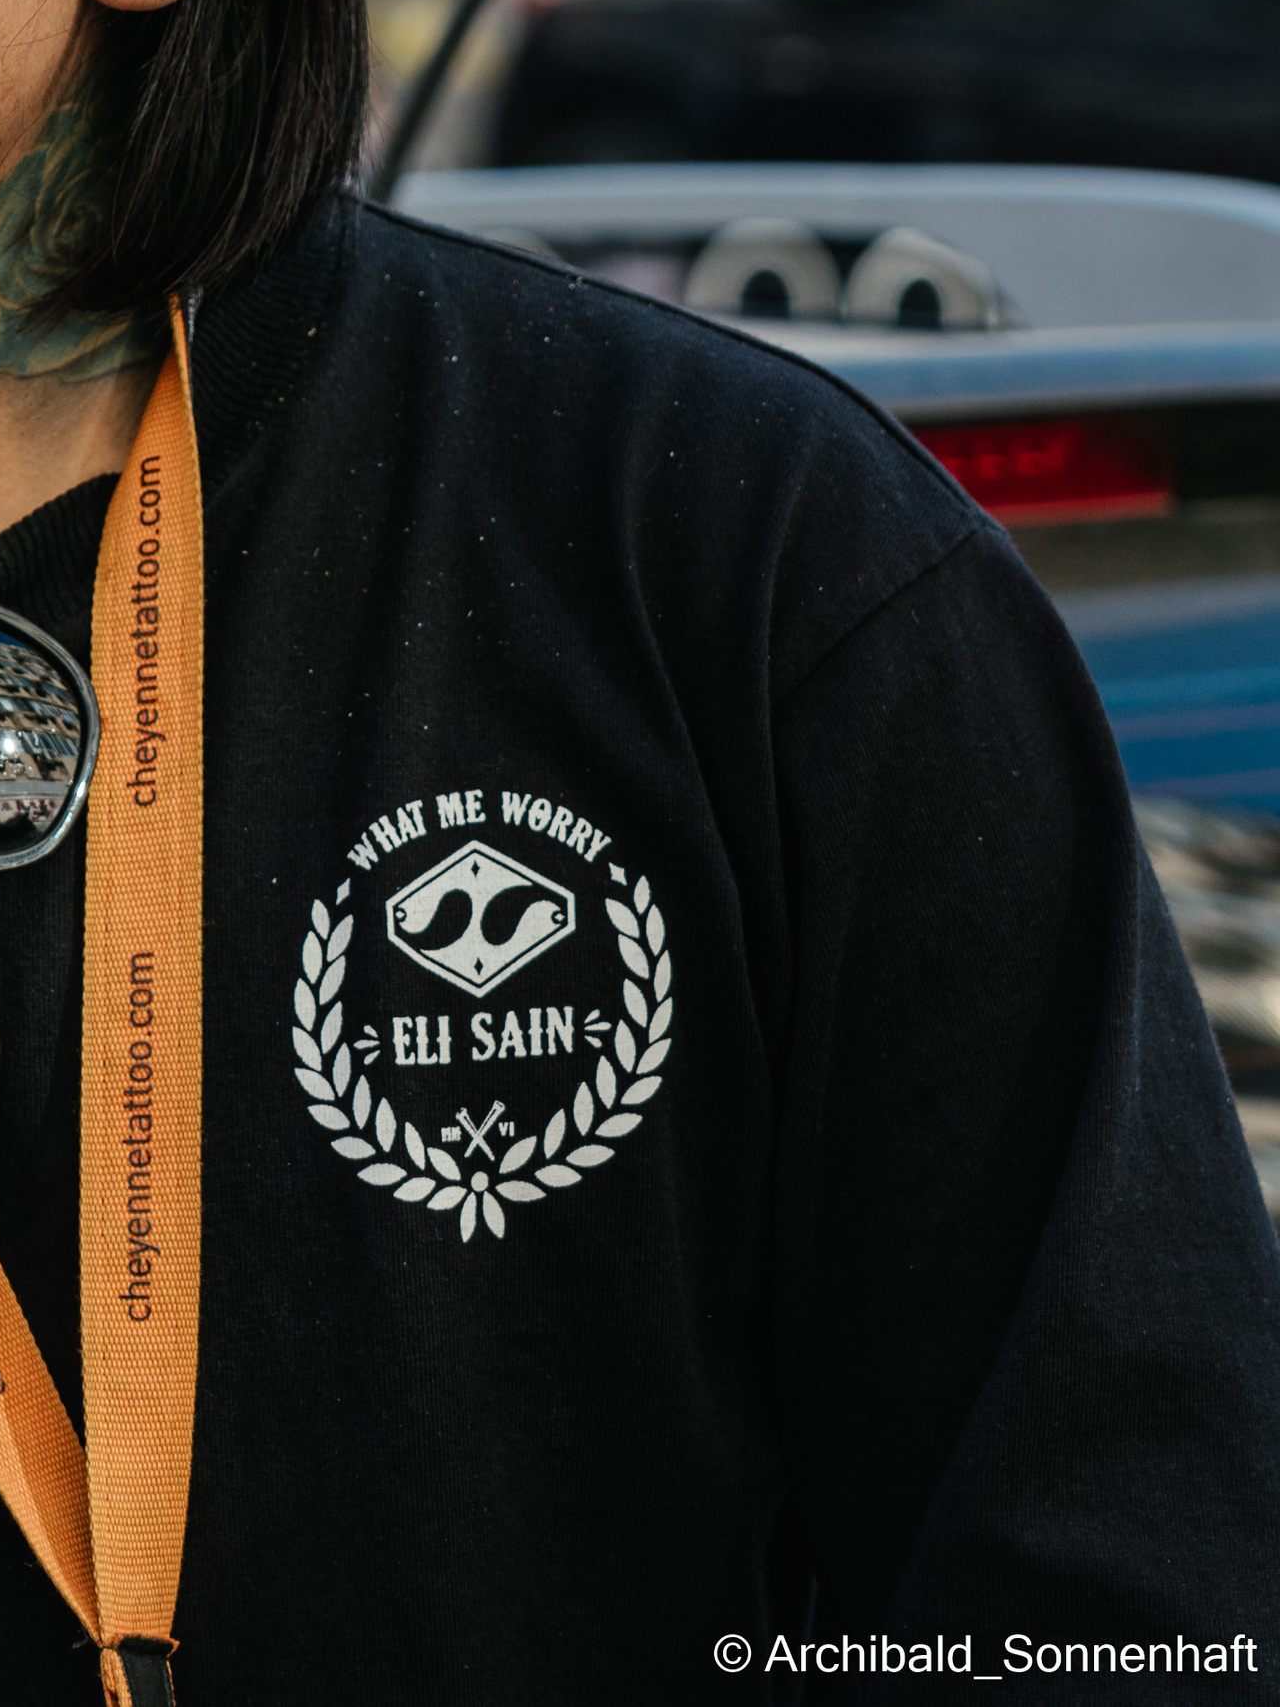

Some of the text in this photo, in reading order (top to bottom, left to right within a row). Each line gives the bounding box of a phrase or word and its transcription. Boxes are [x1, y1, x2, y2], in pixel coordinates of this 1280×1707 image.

[126, 454, 166, 807] cheyennetattoo.com
[347, 788, 612, 871] WHAT ME WORRY
[119, 950, 161, 1322] cheyennetattoo.com
[392, 1005, 575, 1066] ELI SAIN
